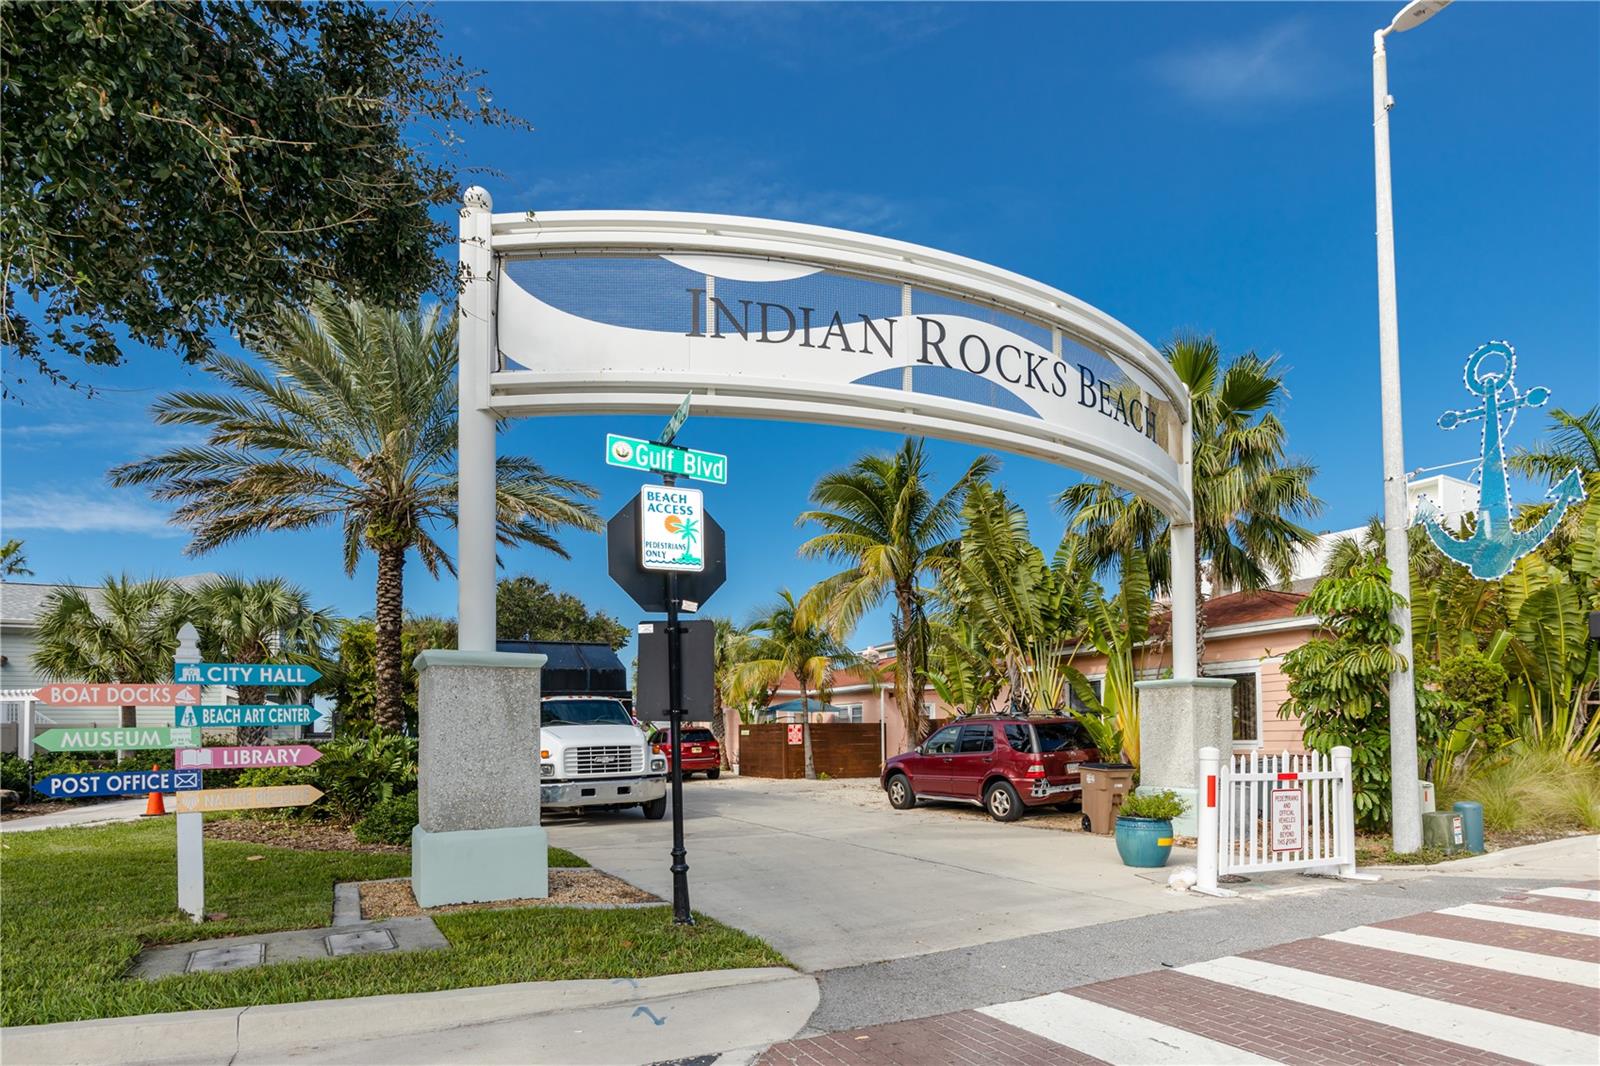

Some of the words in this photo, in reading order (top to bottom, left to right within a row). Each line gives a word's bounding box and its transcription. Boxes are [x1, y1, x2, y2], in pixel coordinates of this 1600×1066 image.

[686, 287, 898, 358] INDIAN
[916, 316, 1067, 398] ROCKS
[1077, 363, 1157, 443] BEACH
[635, 444, 675, 468] Gulf
[683, 451, 724, 480] Blvd
[647, 491, 687, 504] BEACH
[648, 503, 693, 515] ACCESS
[645, 541, 686, 551] PEDESTRIANS
[645, 550, 666, 559] ONLY
[207, 667, 252, 683] CITY
[260, 667, 306, 683] HALL
[50, 687, 98, 703] BOAT
[111, 687, 171, 703] DOCKS
[202, 708, 241, 724] BEACH
[244, 708, 265, 723] ART
[268, 707, 310, 723] CENTER
[60, 731, 161, 748] MUSEUM
[223, 749, 301, 765] LIBRARY
[50, 776, 100, 794] POST
[107, 774, 169, 791] OFFICE
